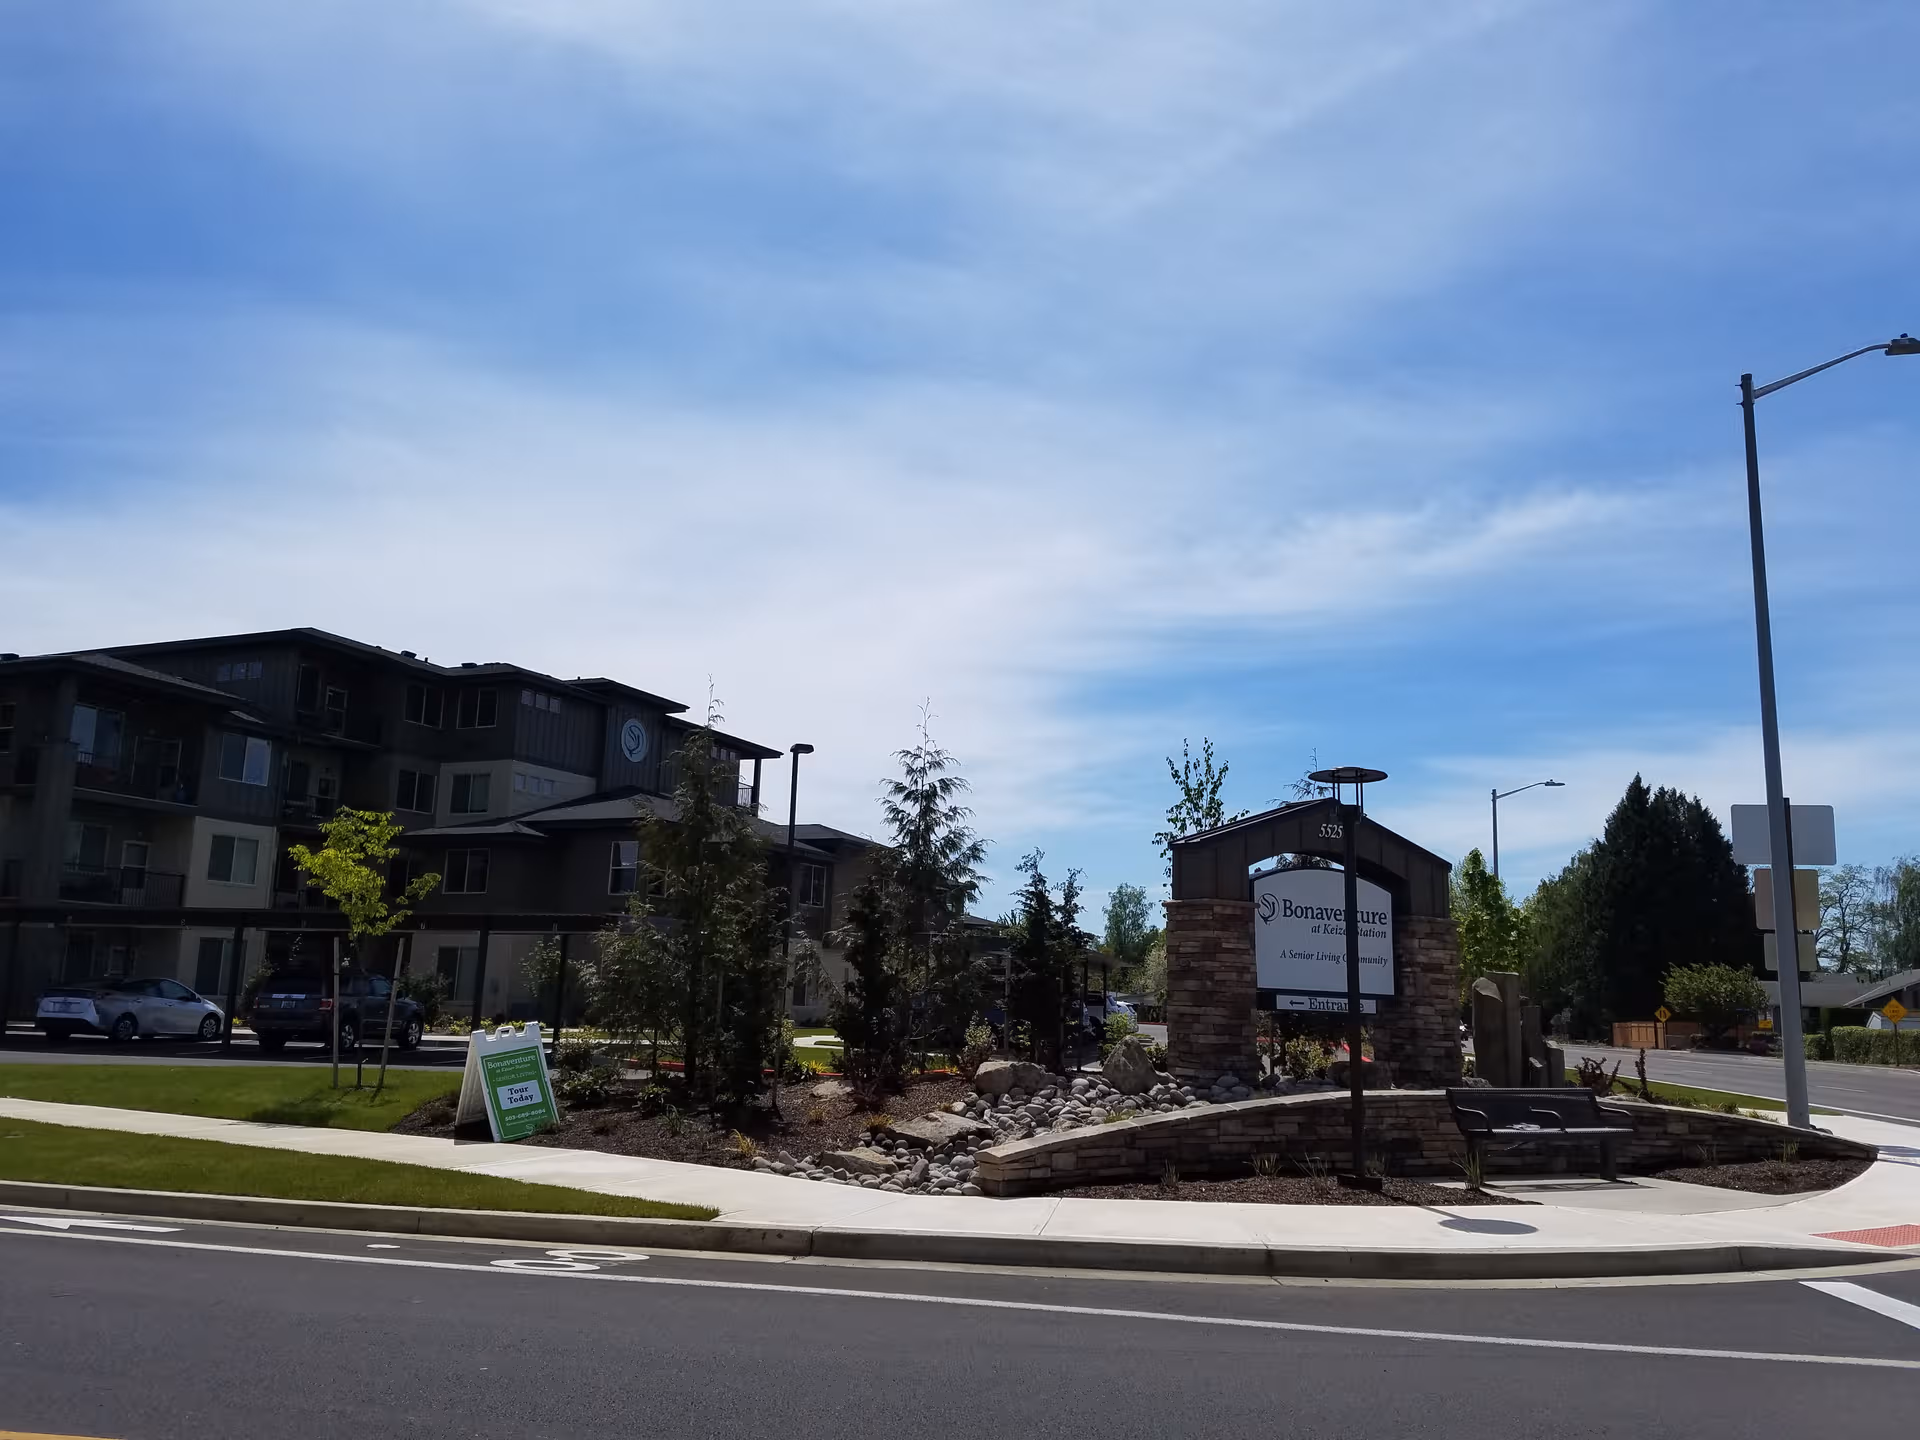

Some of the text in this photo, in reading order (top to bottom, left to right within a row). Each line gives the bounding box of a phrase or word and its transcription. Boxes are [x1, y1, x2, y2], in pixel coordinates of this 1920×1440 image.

[1319, 823, 1344, 839] 5525
[1311, 923, 1322, 934] at
[1357, 926, 1387, 939] tation
[1279, 948, 1287, 959] A
[1288, 949, 1315, 962] Senior
[1316, 951, 1341, 966] Living
[487, 1055, 536, 1069] Bonaventure
[508, 1086, 529, 1096] Tour
[507, 1094, 534, 1105] Today
